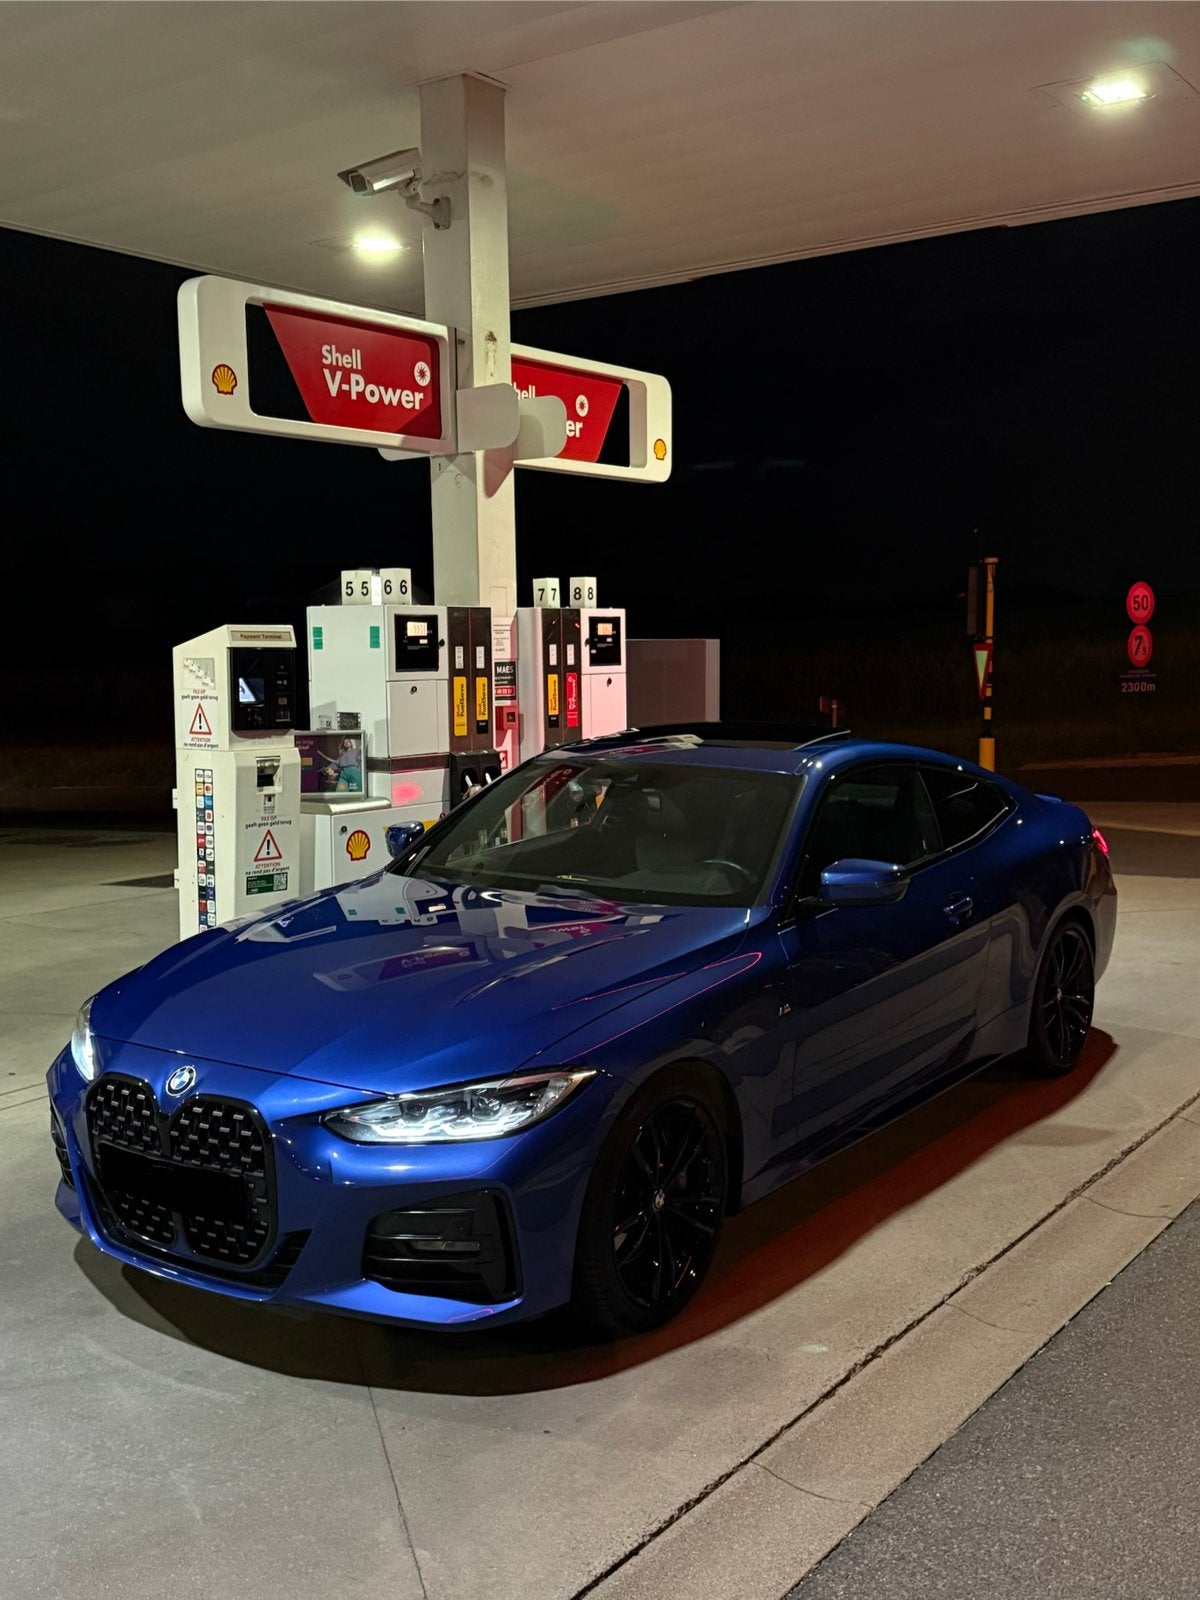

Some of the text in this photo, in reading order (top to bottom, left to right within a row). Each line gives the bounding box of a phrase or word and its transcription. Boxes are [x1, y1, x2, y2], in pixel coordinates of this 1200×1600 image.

[321, 343, 362, 371] Shell
[322, 367, 425, 411] V-Power
[513, 381, 536, 400] hell
[1132, 594, 1149, 611] 50
[496, 665, 514, 674] MAES
[1121, 682, 1156, 693] 2300m
